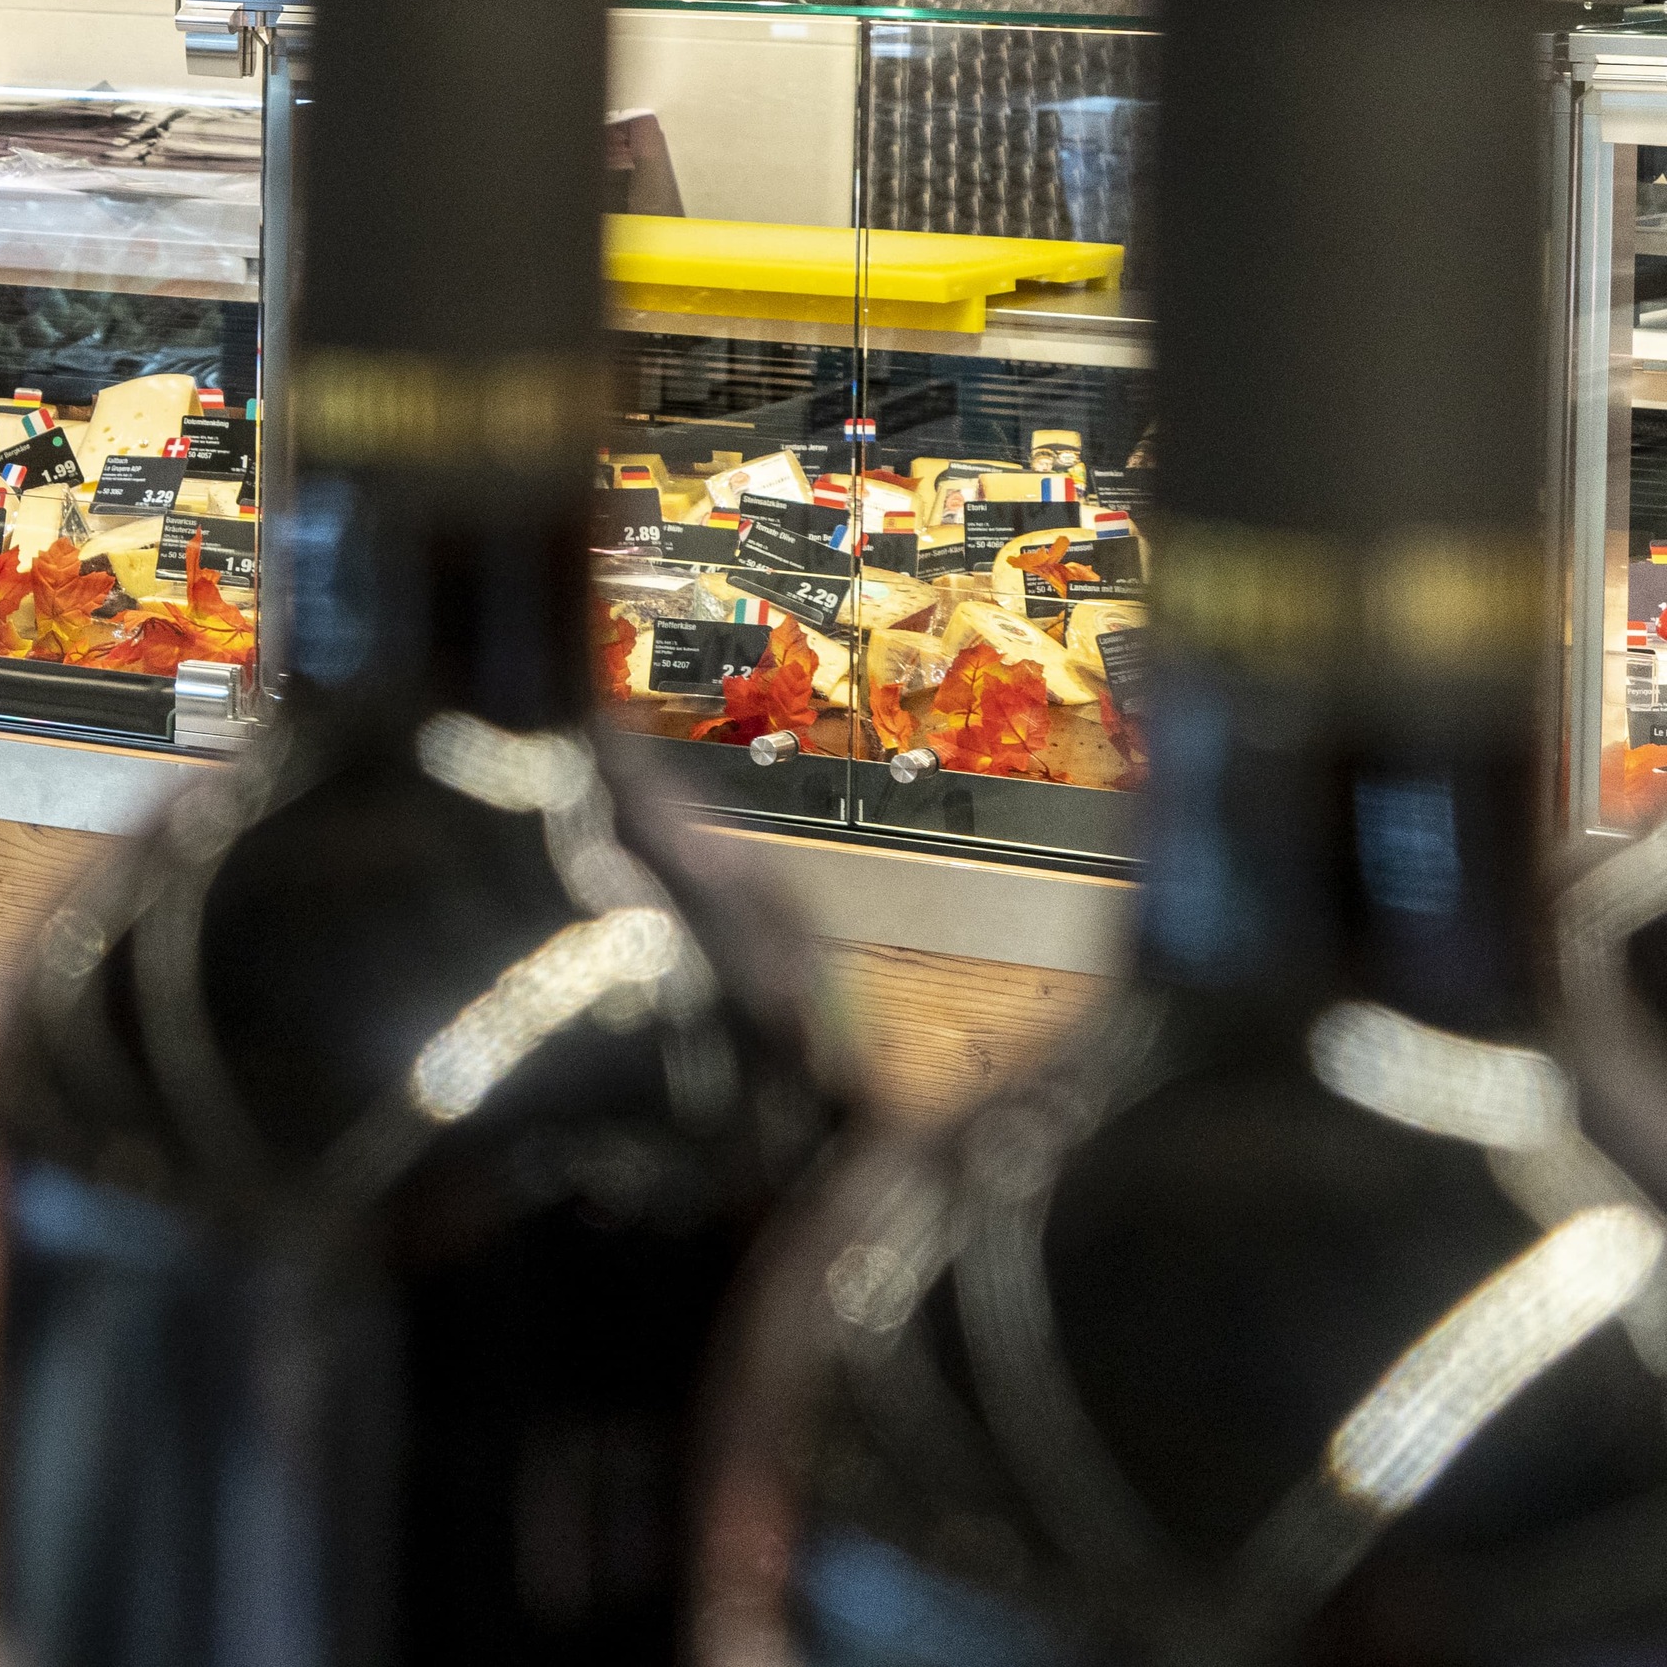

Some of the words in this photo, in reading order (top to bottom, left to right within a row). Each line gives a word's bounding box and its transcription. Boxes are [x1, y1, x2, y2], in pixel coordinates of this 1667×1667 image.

[183, 417, 230, 428] Dolomitenkönig
[3, 443, 31, 458] Bergkäse
[41, 459, 77, 483] 1.99
[142, 489, 175, 504] 3.29
[742, 495, 787, 510] Steinsalzkäse
[967, 504, 987, 512] Etorki
[166, 516, 198, 526] Bavaricus
[624, 525, 660, 541] 2.89
[755, 521, 779, 537] Tomate
[779, 531, 796, 544] Olive
[976, 541, 986, 549] 50
[168, 551, 176, 559] 50
[746, 559, 755, 567] 50
[1036, 586, 1046, 594] 50
[1069, 583, 1100, 592] Landana
[796, 582, 838, 608] 2.29
[657, 620, 697, 631] Pfefferkäse
[661, 659, 671, 667] 50
[672, 660, 690, 669] 4207
[1653, 728, 1664, 737] Le
